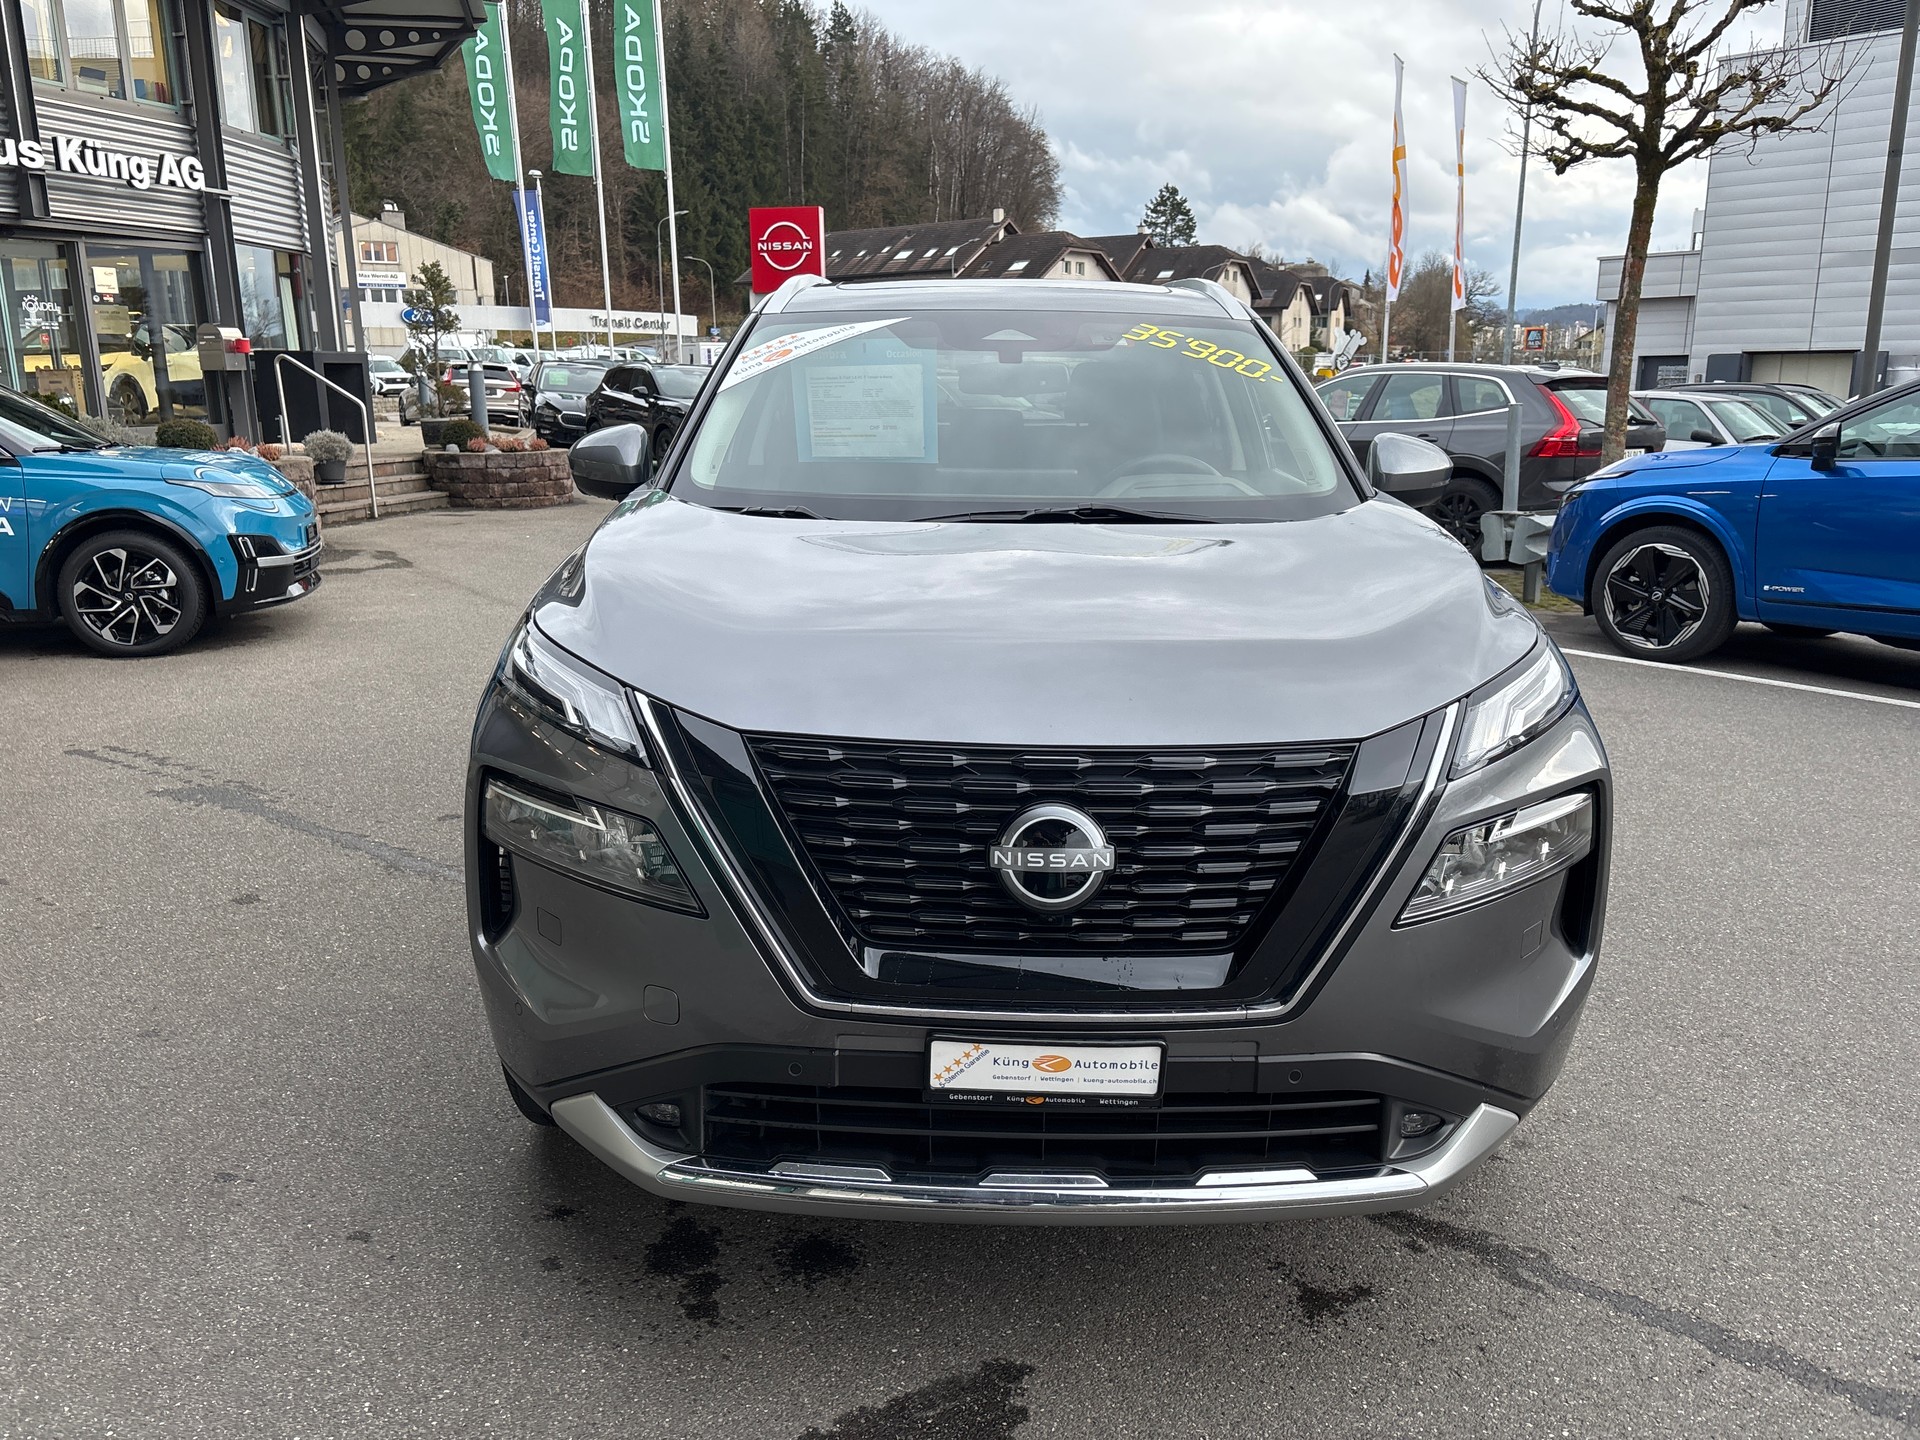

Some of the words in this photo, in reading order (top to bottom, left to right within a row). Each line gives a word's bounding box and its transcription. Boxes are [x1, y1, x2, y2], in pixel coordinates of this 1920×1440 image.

[54, 136, 151, 190] Küng
[158, 153, 206, 191] AG
[757, 241, 813, 251] NISSAN
[591, 315, 632, 329] Transit
[633, 318, 670, 330] Center
[733, 361, 763, 376] Küng
[793, 325, 856, 350] Automobile
[886, 349, 921, 358] Occasion
[994, 850, 1110, 867] NISSAN
[939, 1069, 965, 1088] 5-Sterne
[964, 1049, 990, 1069] Garantie
[993, 1057, 1029, 1069] Küng
[1074, 1060, 1159, 1070] Automobile
[949, 1093, 993, 1101] Gebenstorf
